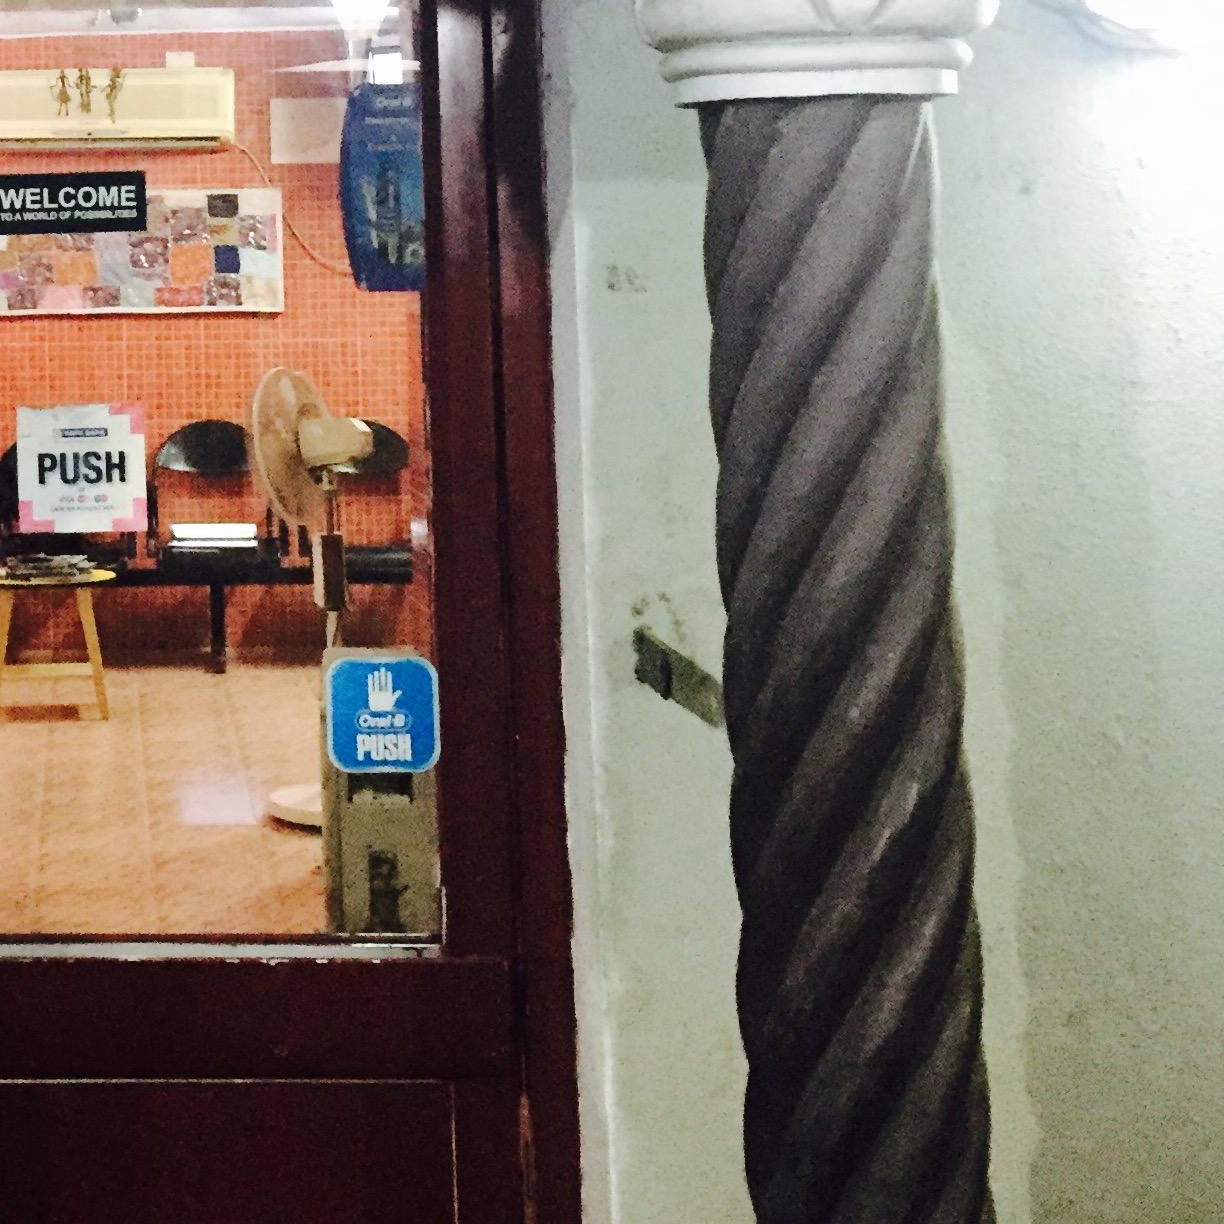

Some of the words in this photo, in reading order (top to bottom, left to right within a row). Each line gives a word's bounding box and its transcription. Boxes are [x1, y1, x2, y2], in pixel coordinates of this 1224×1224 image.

[0, 185, 137, 210] WELCOME
[22, 211, 57, 221] WORLD
[37, 451, 126, 485] PUSH
[356, 733, 412, 761] PUSH
